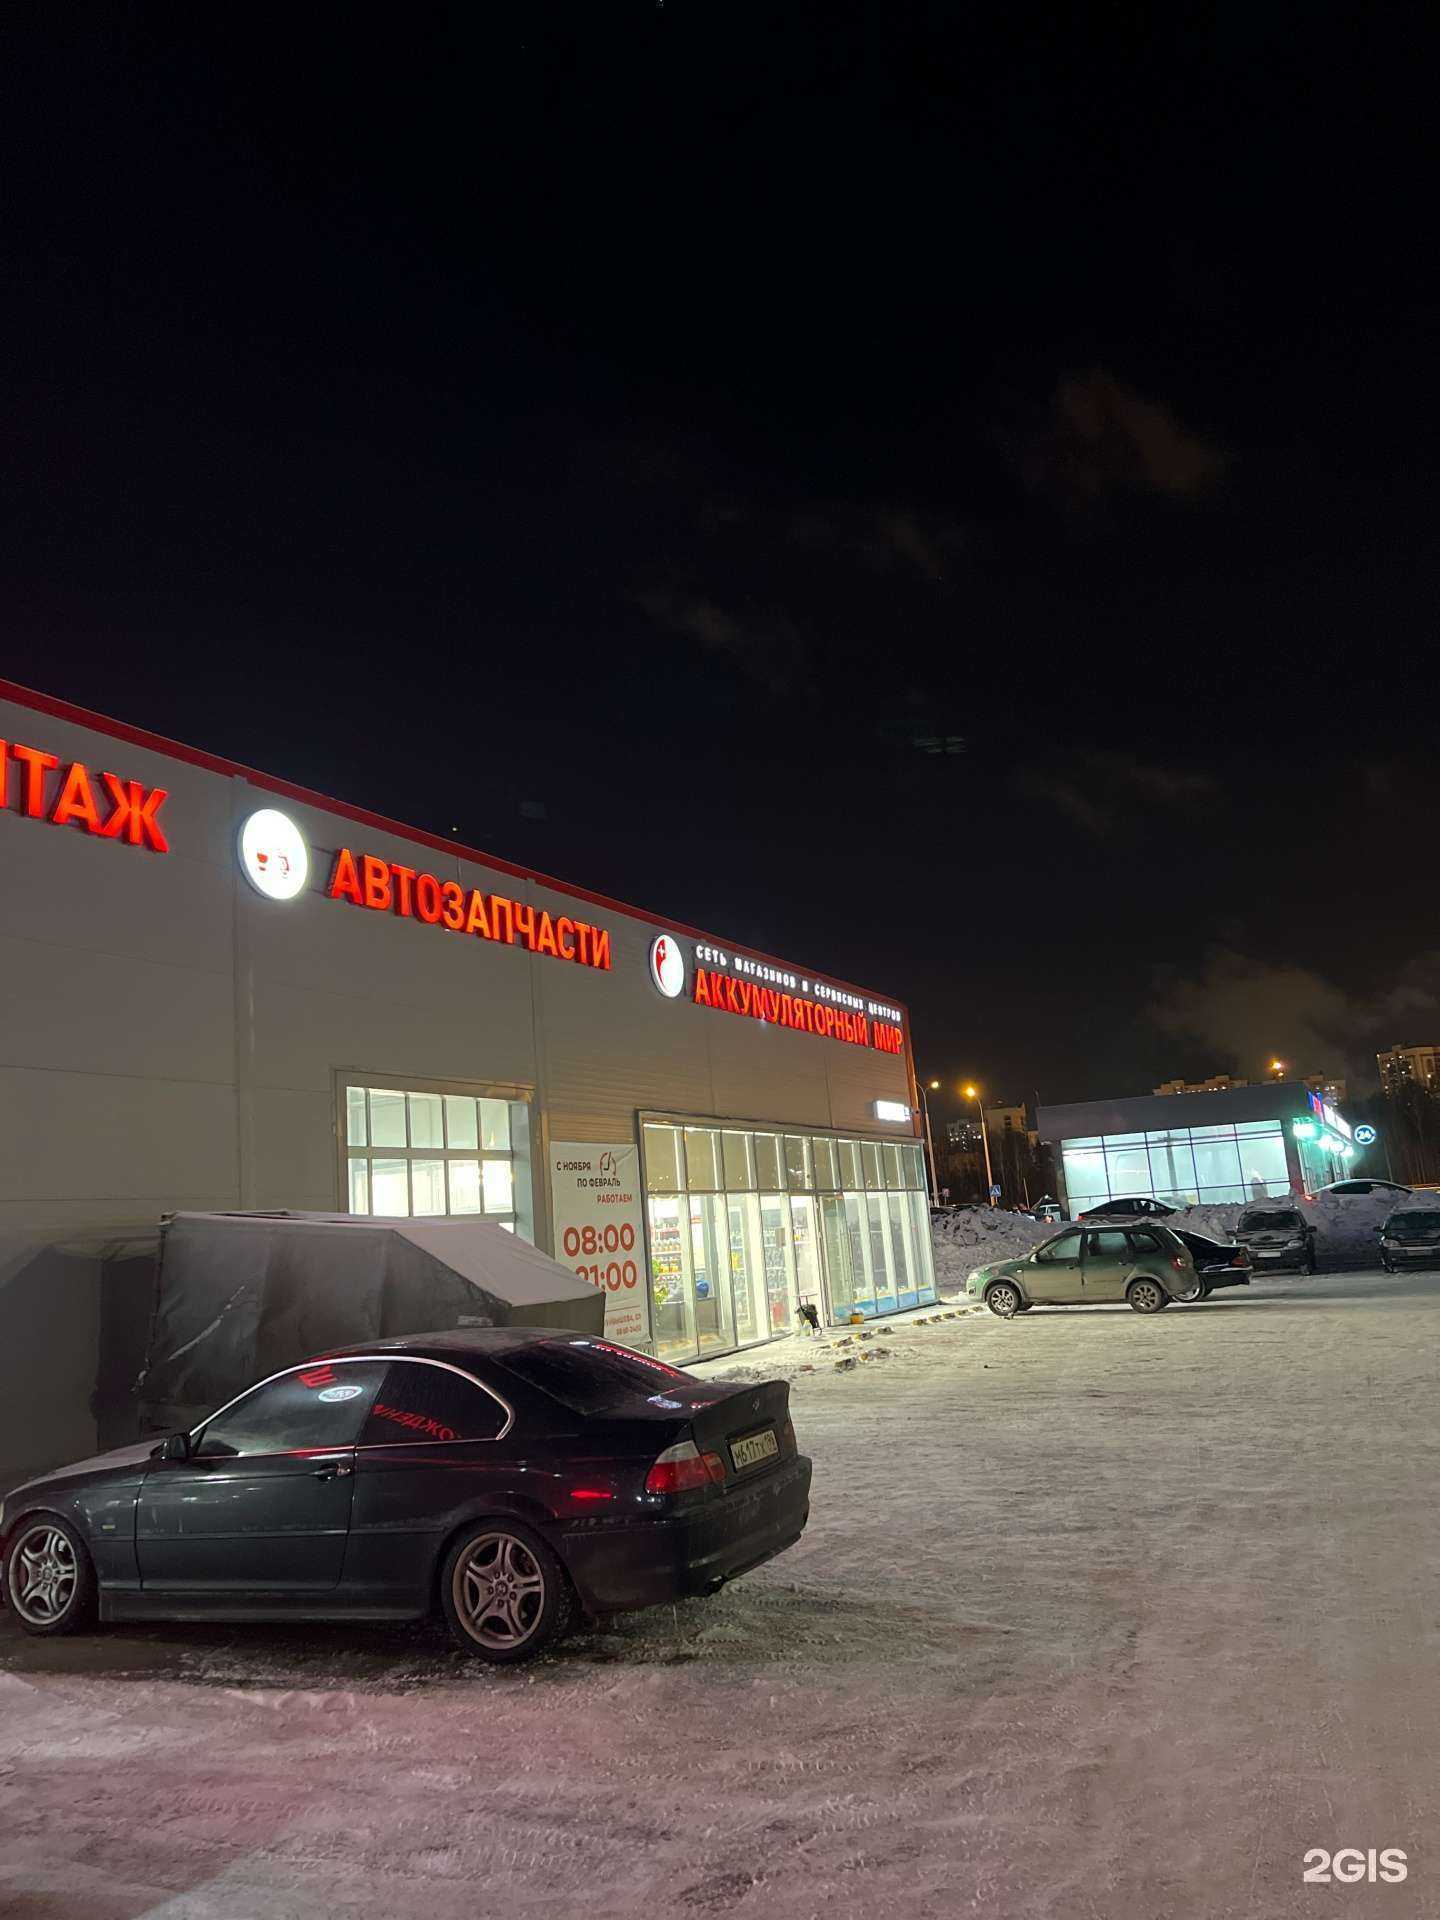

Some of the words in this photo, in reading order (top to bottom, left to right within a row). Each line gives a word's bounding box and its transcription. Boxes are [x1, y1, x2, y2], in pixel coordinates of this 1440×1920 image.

[0, 738, 169, 853] ТАЖ
[328, 848, 612, 970] АВТОЗАПЧАСТИ
[694, 968, 868, 1046] АККУМУЛЯТОРНЫЙ
[873, 1021, 904, 1054] МИР
[696, 945, 727, 967] СЕТЬ
[735, 957, 796, 989] МАГАЗИНОВ
[802, 980, 809, 992] И
[814, 984, 864, 1010] СЕРВИСНЫХ
[868, 1001, 902, 1022] ЦЕНТРОВ
[556, 1162, 562, 1171] С
[563, 1161, 591, 1171] НОЯБРЯ
[577, 1178, 587, 1187] ПО
[589, 1177, 621, 1187] ФЕВРАЛЬ
[597, 1193, 633, 1204] РАБОТАЕМ
[564, 1223, 635, 1257] 08:00
